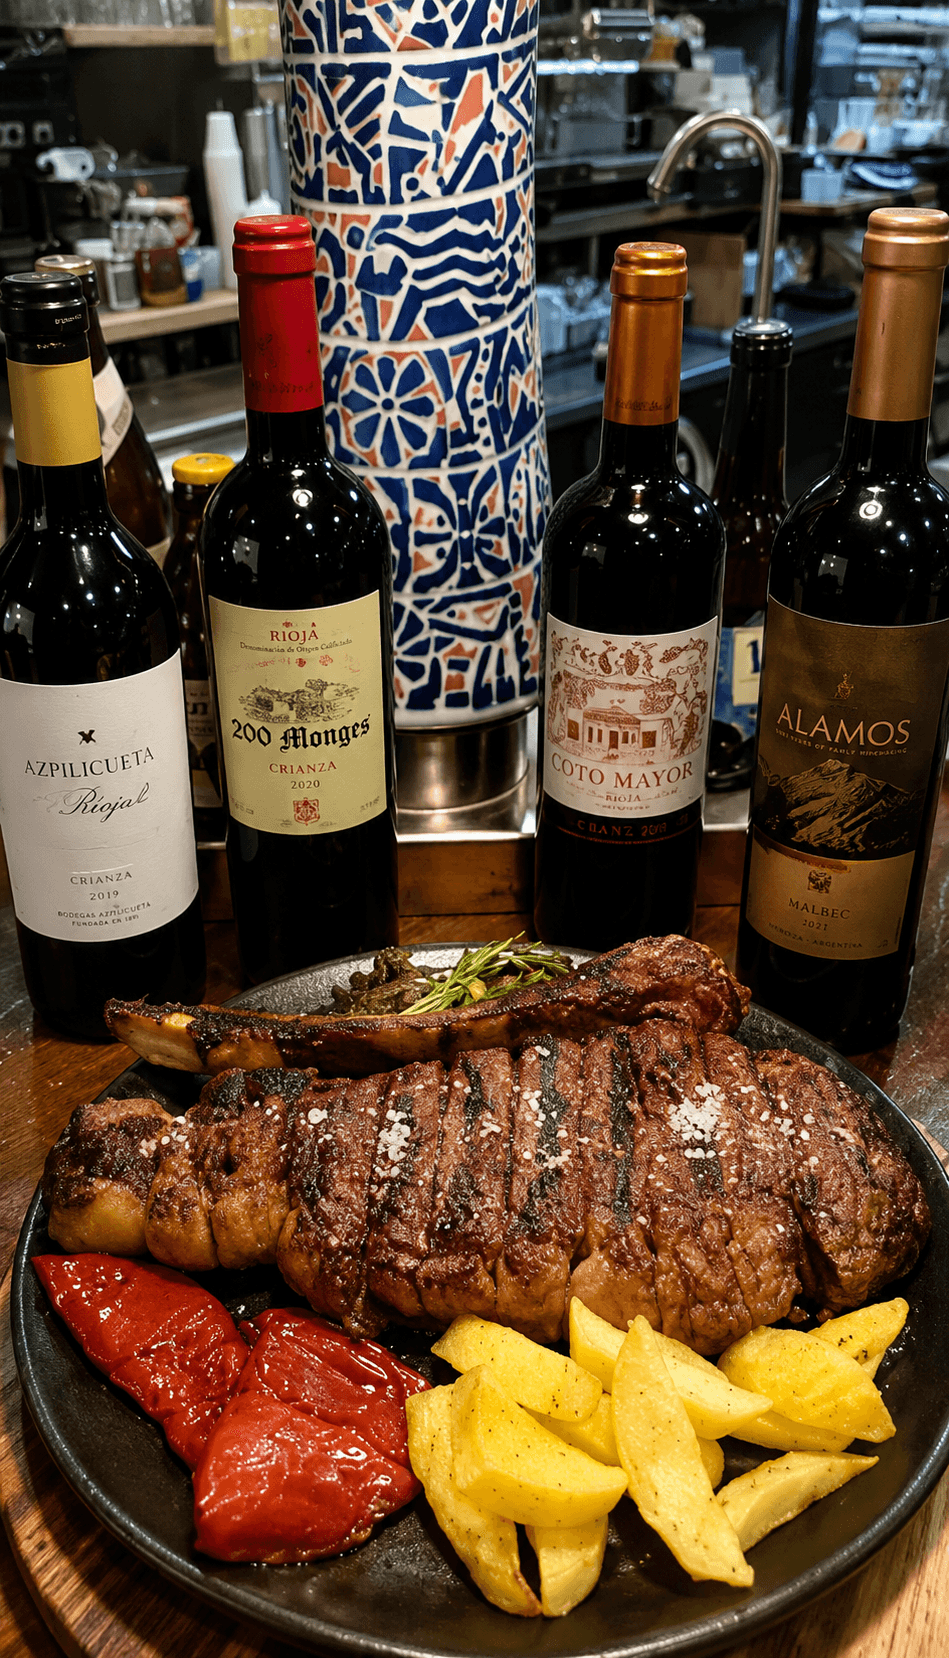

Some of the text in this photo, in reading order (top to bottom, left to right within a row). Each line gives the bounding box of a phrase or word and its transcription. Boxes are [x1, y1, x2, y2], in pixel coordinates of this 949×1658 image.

[270, 629, 319, 645] RIOJA
[777, 703, 911, 747] ALAMOS
[231, 713, 371, 754] 200 Monges
[24, 746, 155, 778] AZPILICUETA
[269, 761, 337, 775] CRIANZA
[551, 752, 693, 789] COTO MAYOR
[290, 780, 321, 790] 2020
[605, 794, 642, 803] RIOJA
[70, 871, 133, 885] CRIANZA
[89, 890, 119, 901] 2019
[57, 910, 96, 919] BODEGAS
[788, 898, 851, 920] MALBEC
